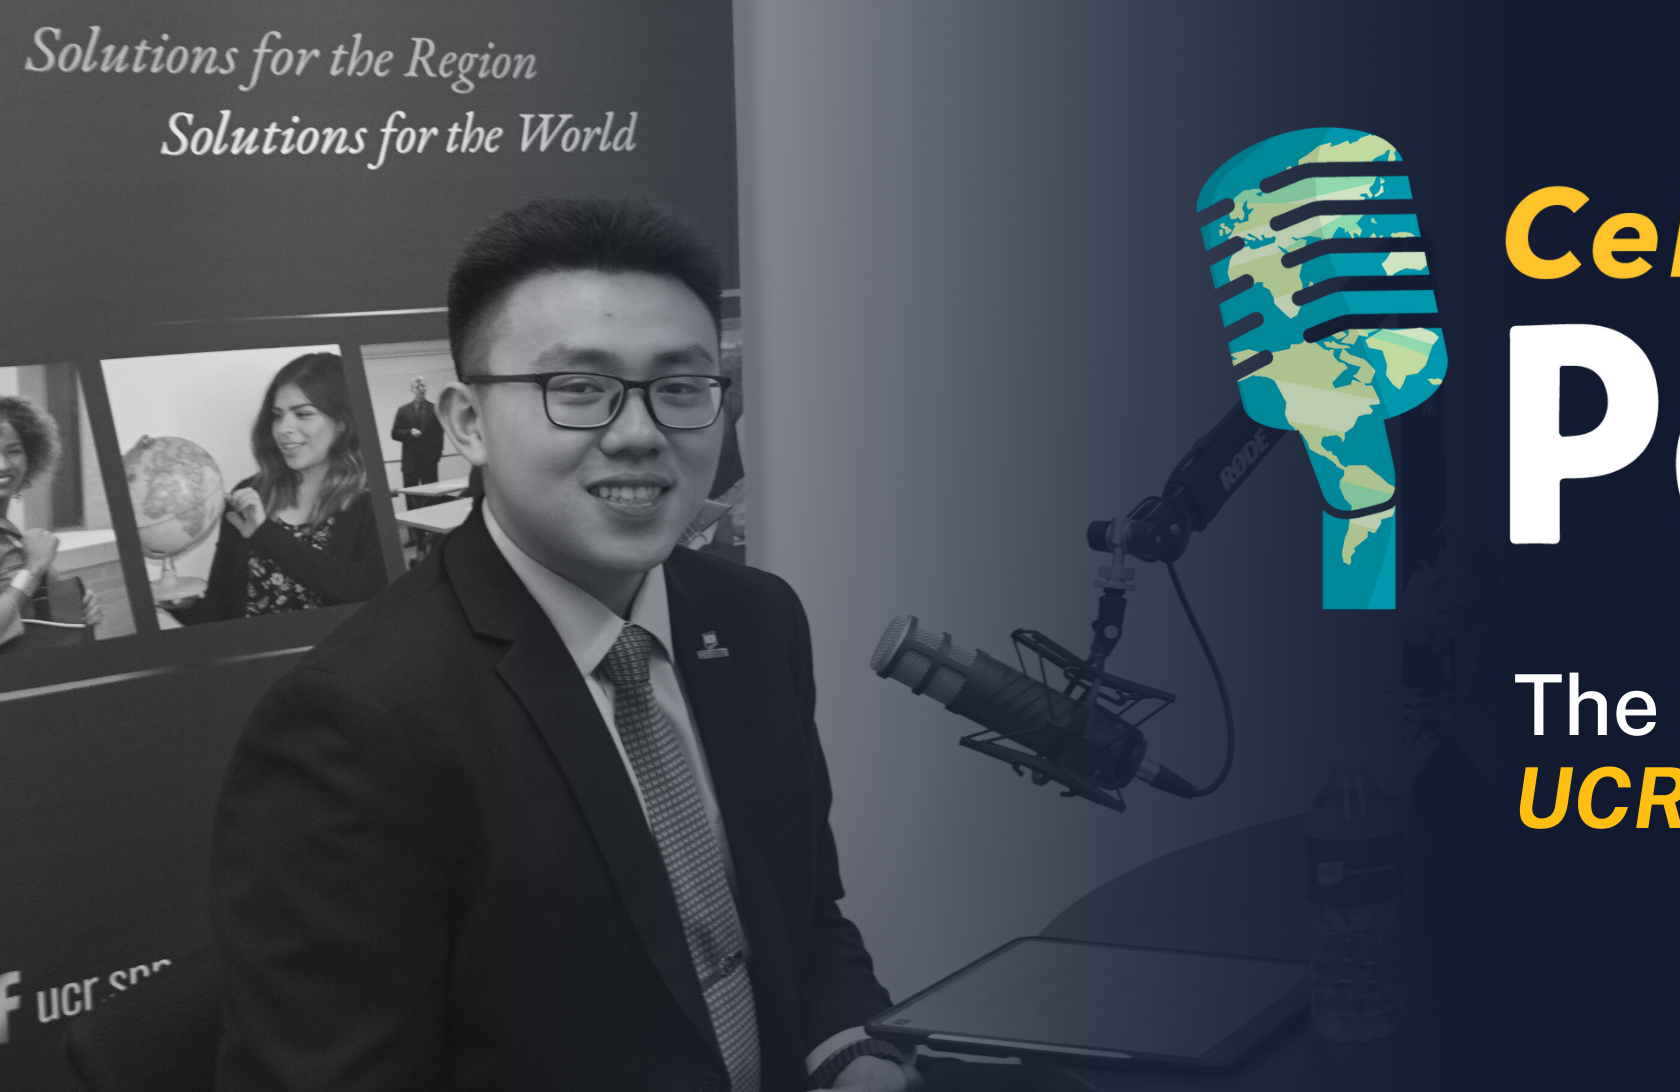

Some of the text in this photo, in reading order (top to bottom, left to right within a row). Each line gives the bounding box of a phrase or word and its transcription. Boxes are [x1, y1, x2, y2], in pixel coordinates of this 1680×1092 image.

[25, 25, 538, 94] Solutions for the Region
[160, 109, 639, 170] Solutions for the World
[37, 976, 100, 1023] ucr
